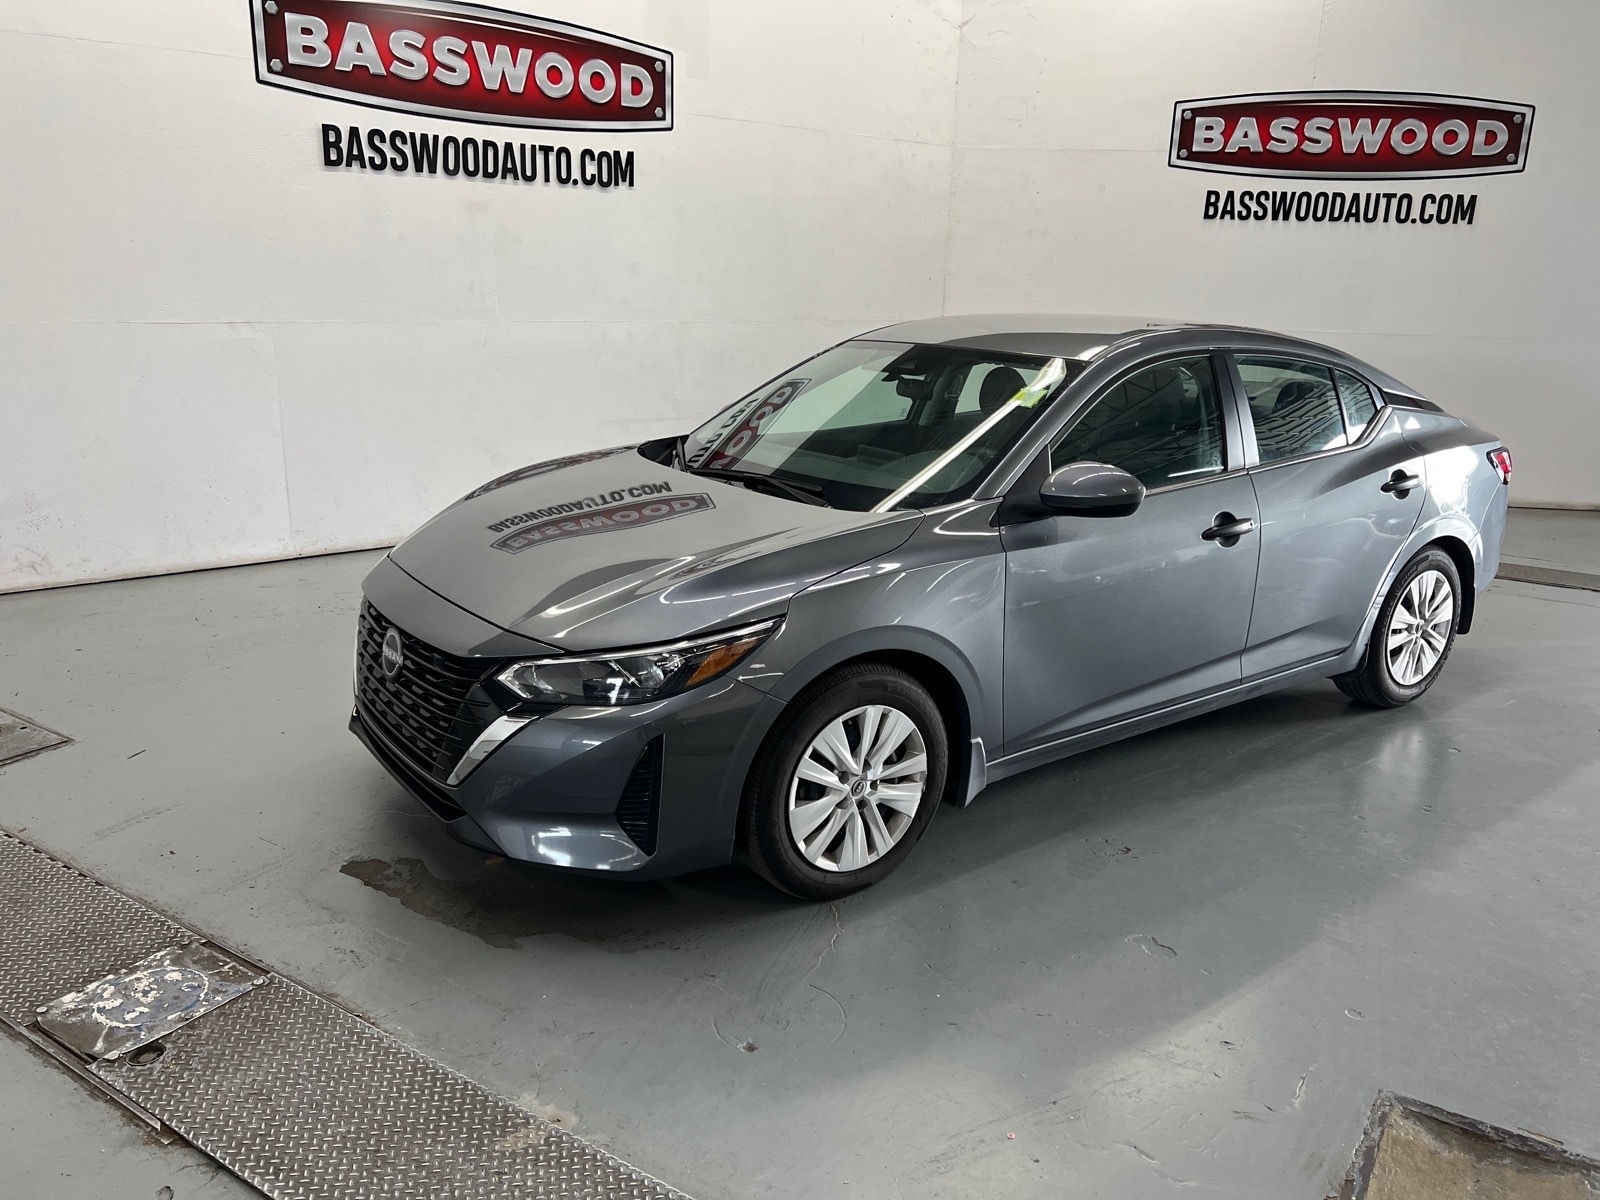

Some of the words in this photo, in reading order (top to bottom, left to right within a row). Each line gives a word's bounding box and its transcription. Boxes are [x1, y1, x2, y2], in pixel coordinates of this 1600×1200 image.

[285, 13, 654, 108] BASSWOOD
[322, 124, 634, 187] BASSWOODAUTO.COM
[1192, 117, 1509, 155] BASSWOOD
[1203, 190, 1477, 225] BASSWOODAUTO.COM
